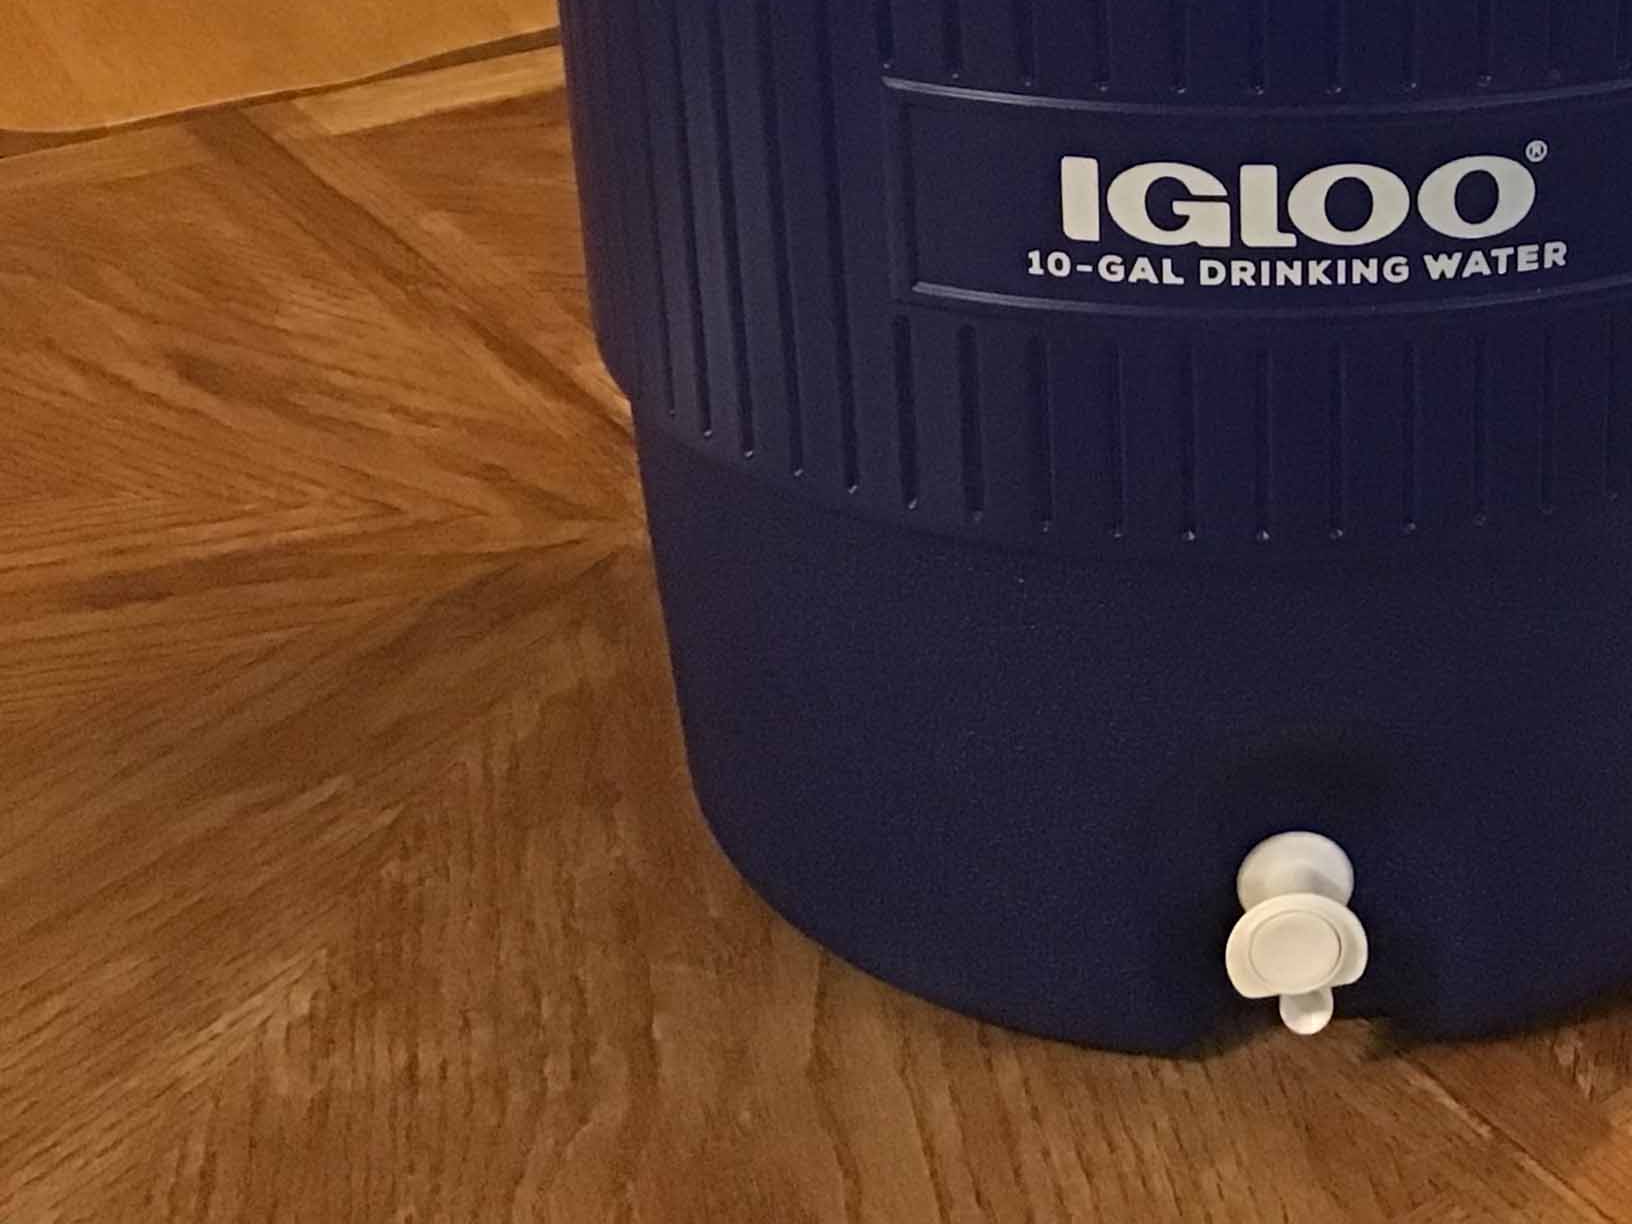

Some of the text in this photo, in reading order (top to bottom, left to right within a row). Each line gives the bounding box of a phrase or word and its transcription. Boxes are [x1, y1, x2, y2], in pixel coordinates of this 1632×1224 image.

[1060, 155, 1536, 247] IGLOO
[1027, 241, 1568, 286] 10-GAL DRINKING WATER
